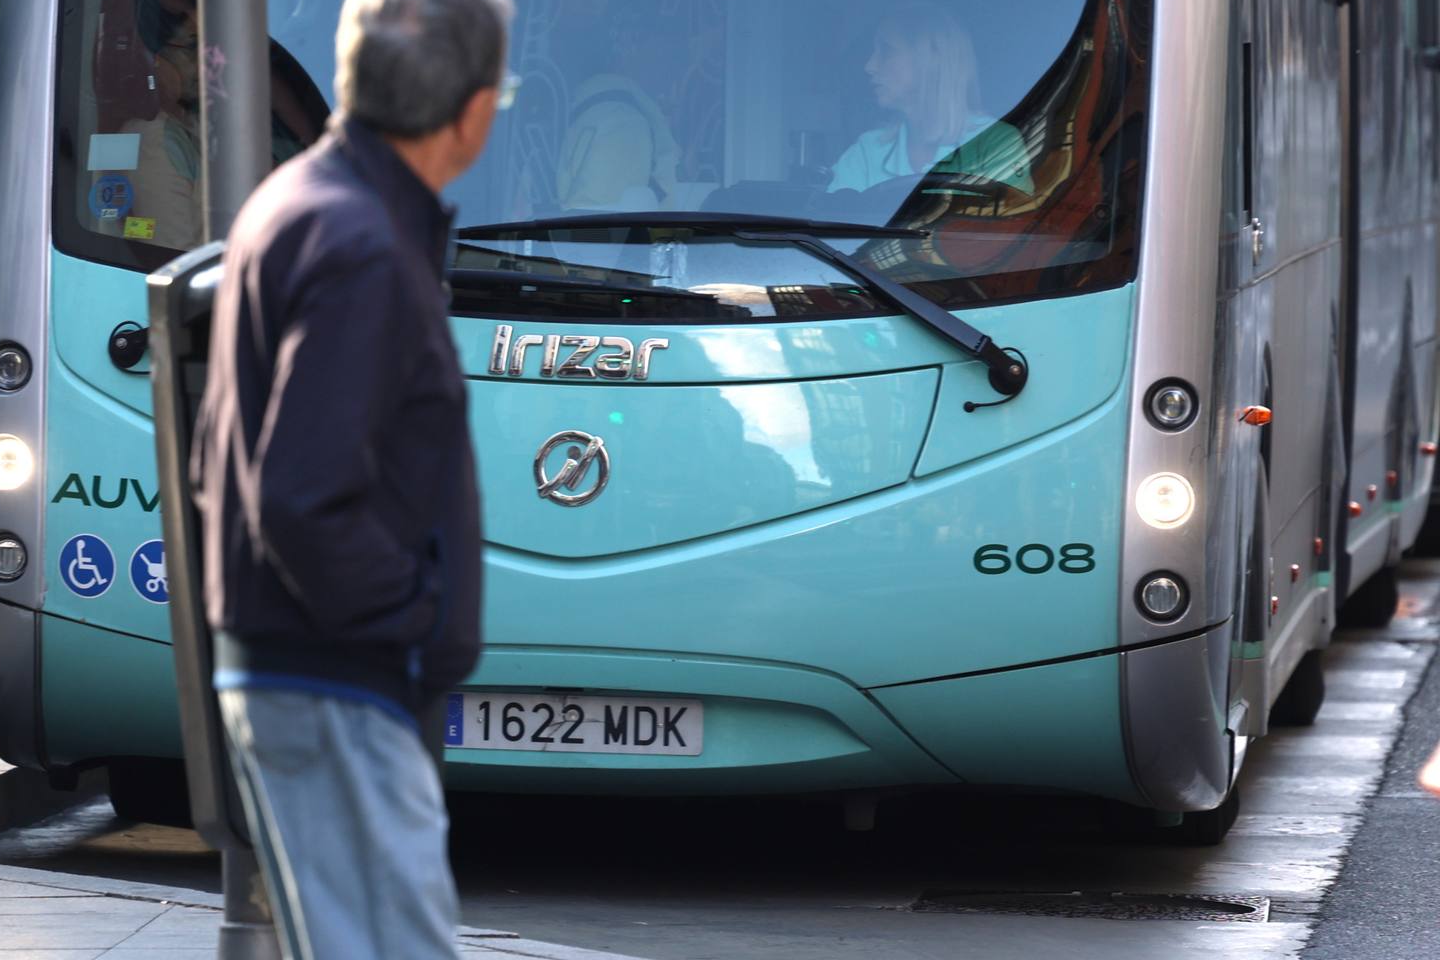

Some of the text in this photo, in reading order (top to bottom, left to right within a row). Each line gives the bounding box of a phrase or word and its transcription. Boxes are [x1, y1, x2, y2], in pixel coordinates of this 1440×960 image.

[51, 473, 162, 514] AUV
[973, 543, 1096, 575] 608
[478, 700, 586, 745] 1622
[603, 704, 688, 748] MDK
